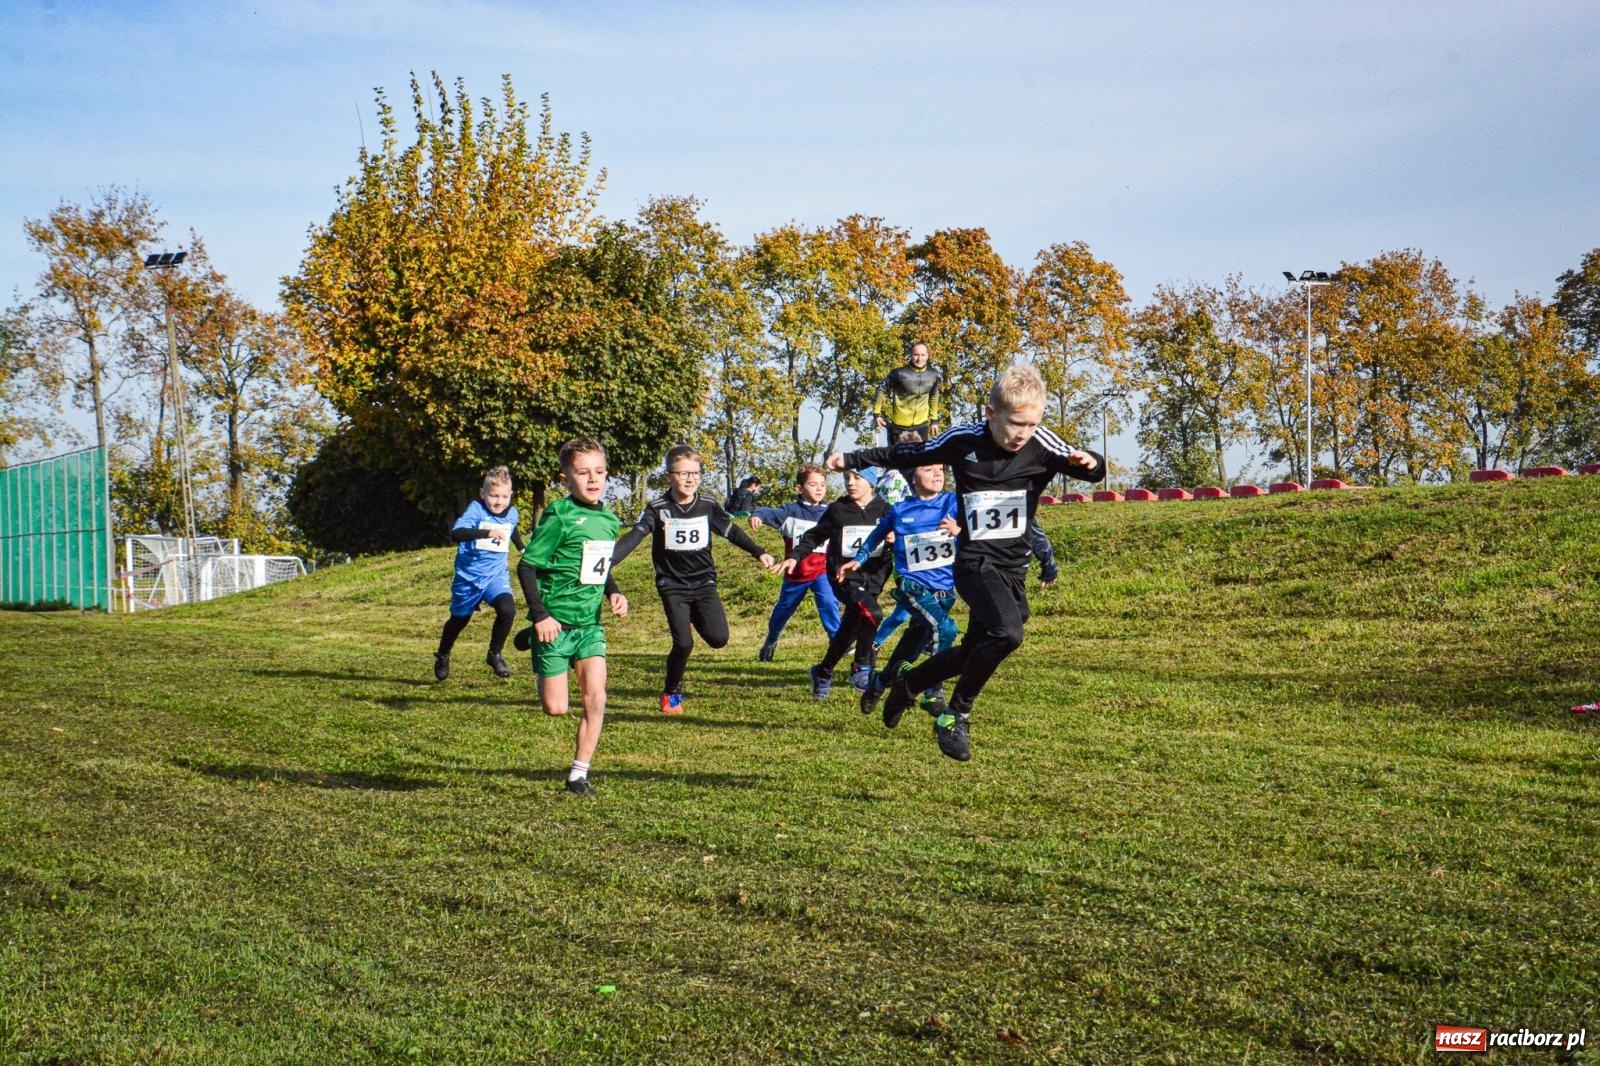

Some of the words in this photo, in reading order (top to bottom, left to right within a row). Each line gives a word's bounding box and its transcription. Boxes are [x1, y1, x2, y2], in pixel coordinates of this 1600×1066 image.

[967, 508, 1019, 530] 131
[675, 529, 700, 544] 58
[910, 542, 953, 564] 133
